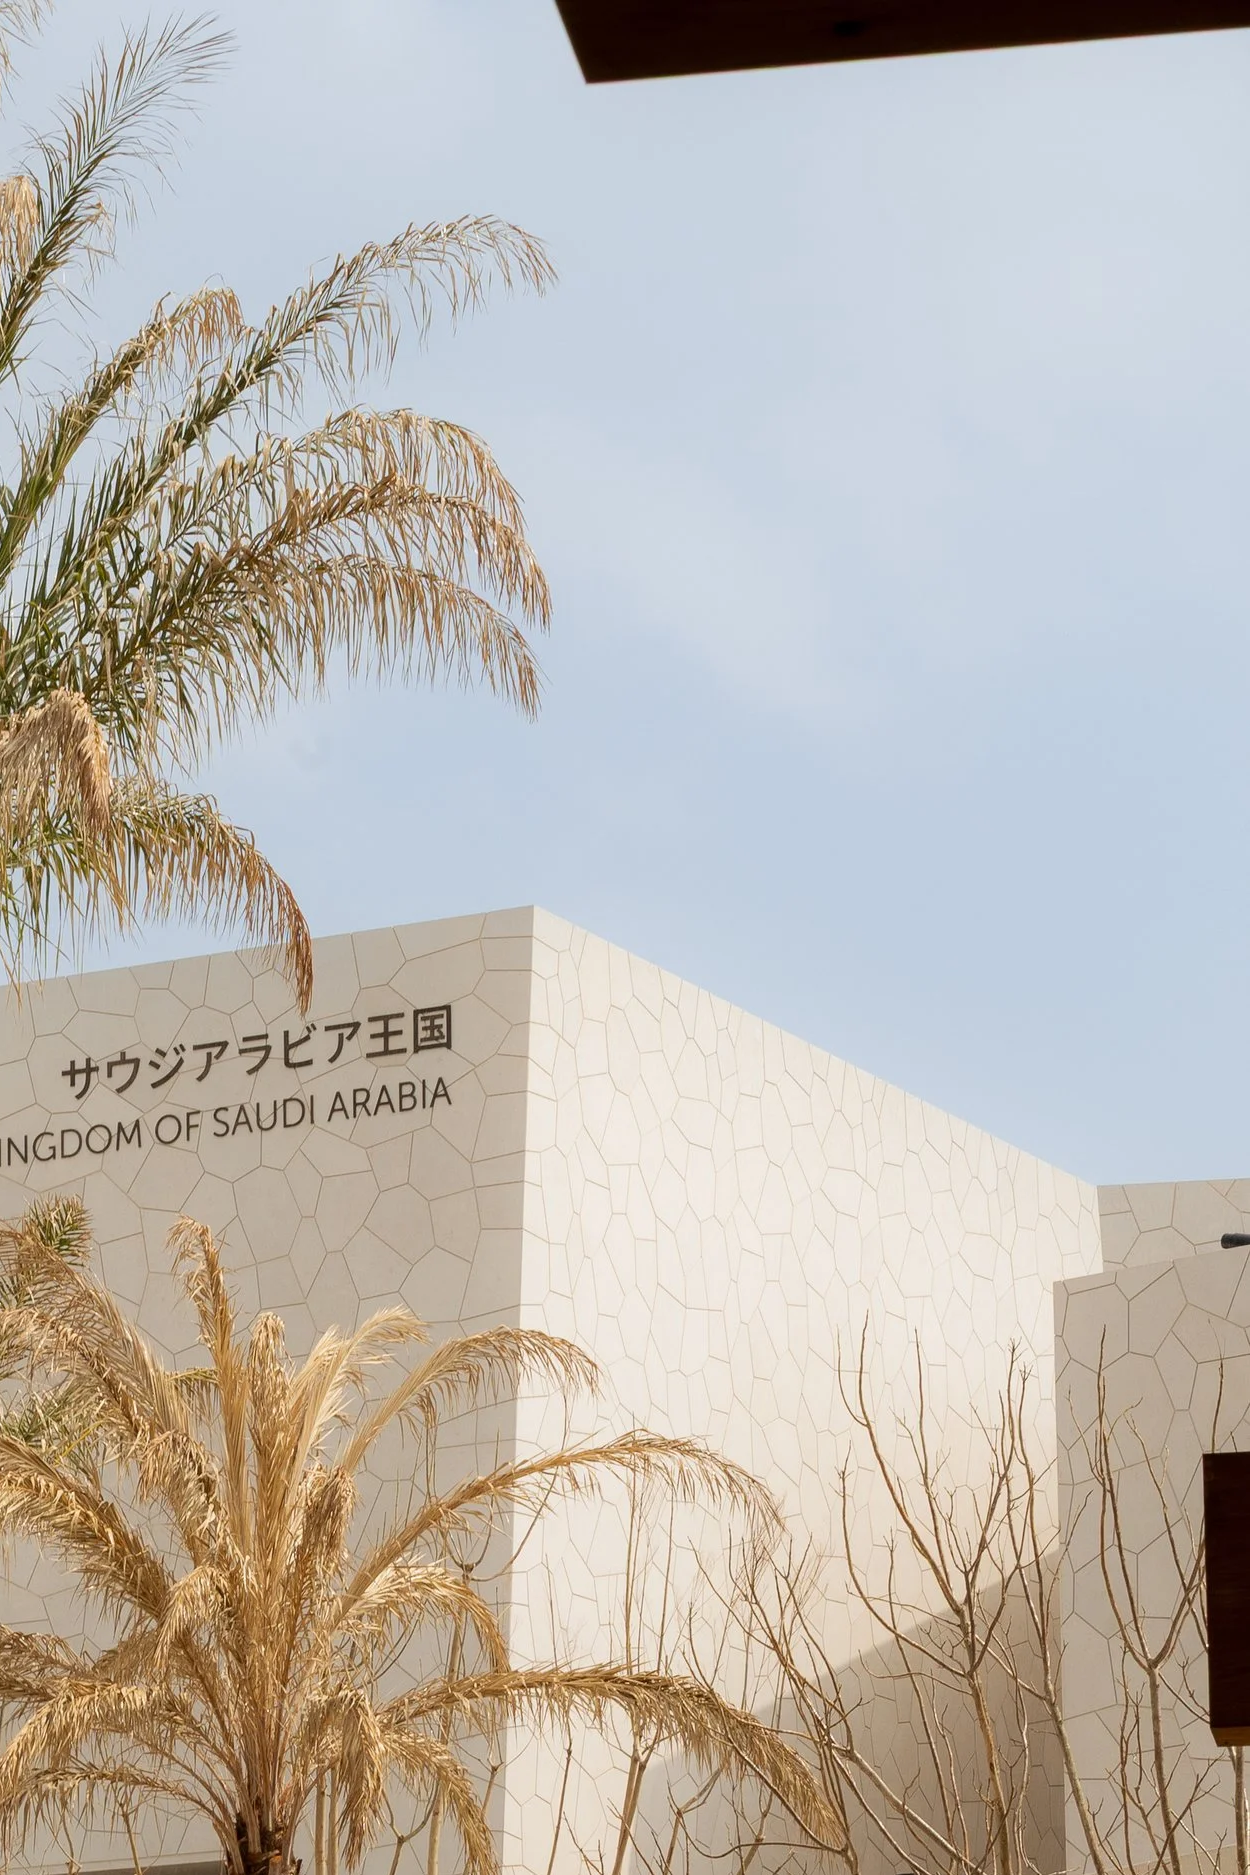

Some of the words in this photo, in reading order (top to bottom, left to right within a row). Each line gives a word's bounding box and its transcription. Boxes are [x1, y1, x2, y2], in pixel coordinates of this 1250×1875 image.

[61, 1004, 453, 1101] サウジアラビア王国
[154, 1109, 202, 1146] OF
[213, 1094, 315, 1138] SAUDI
[327, 1076, 452, 1123] ARABIA
